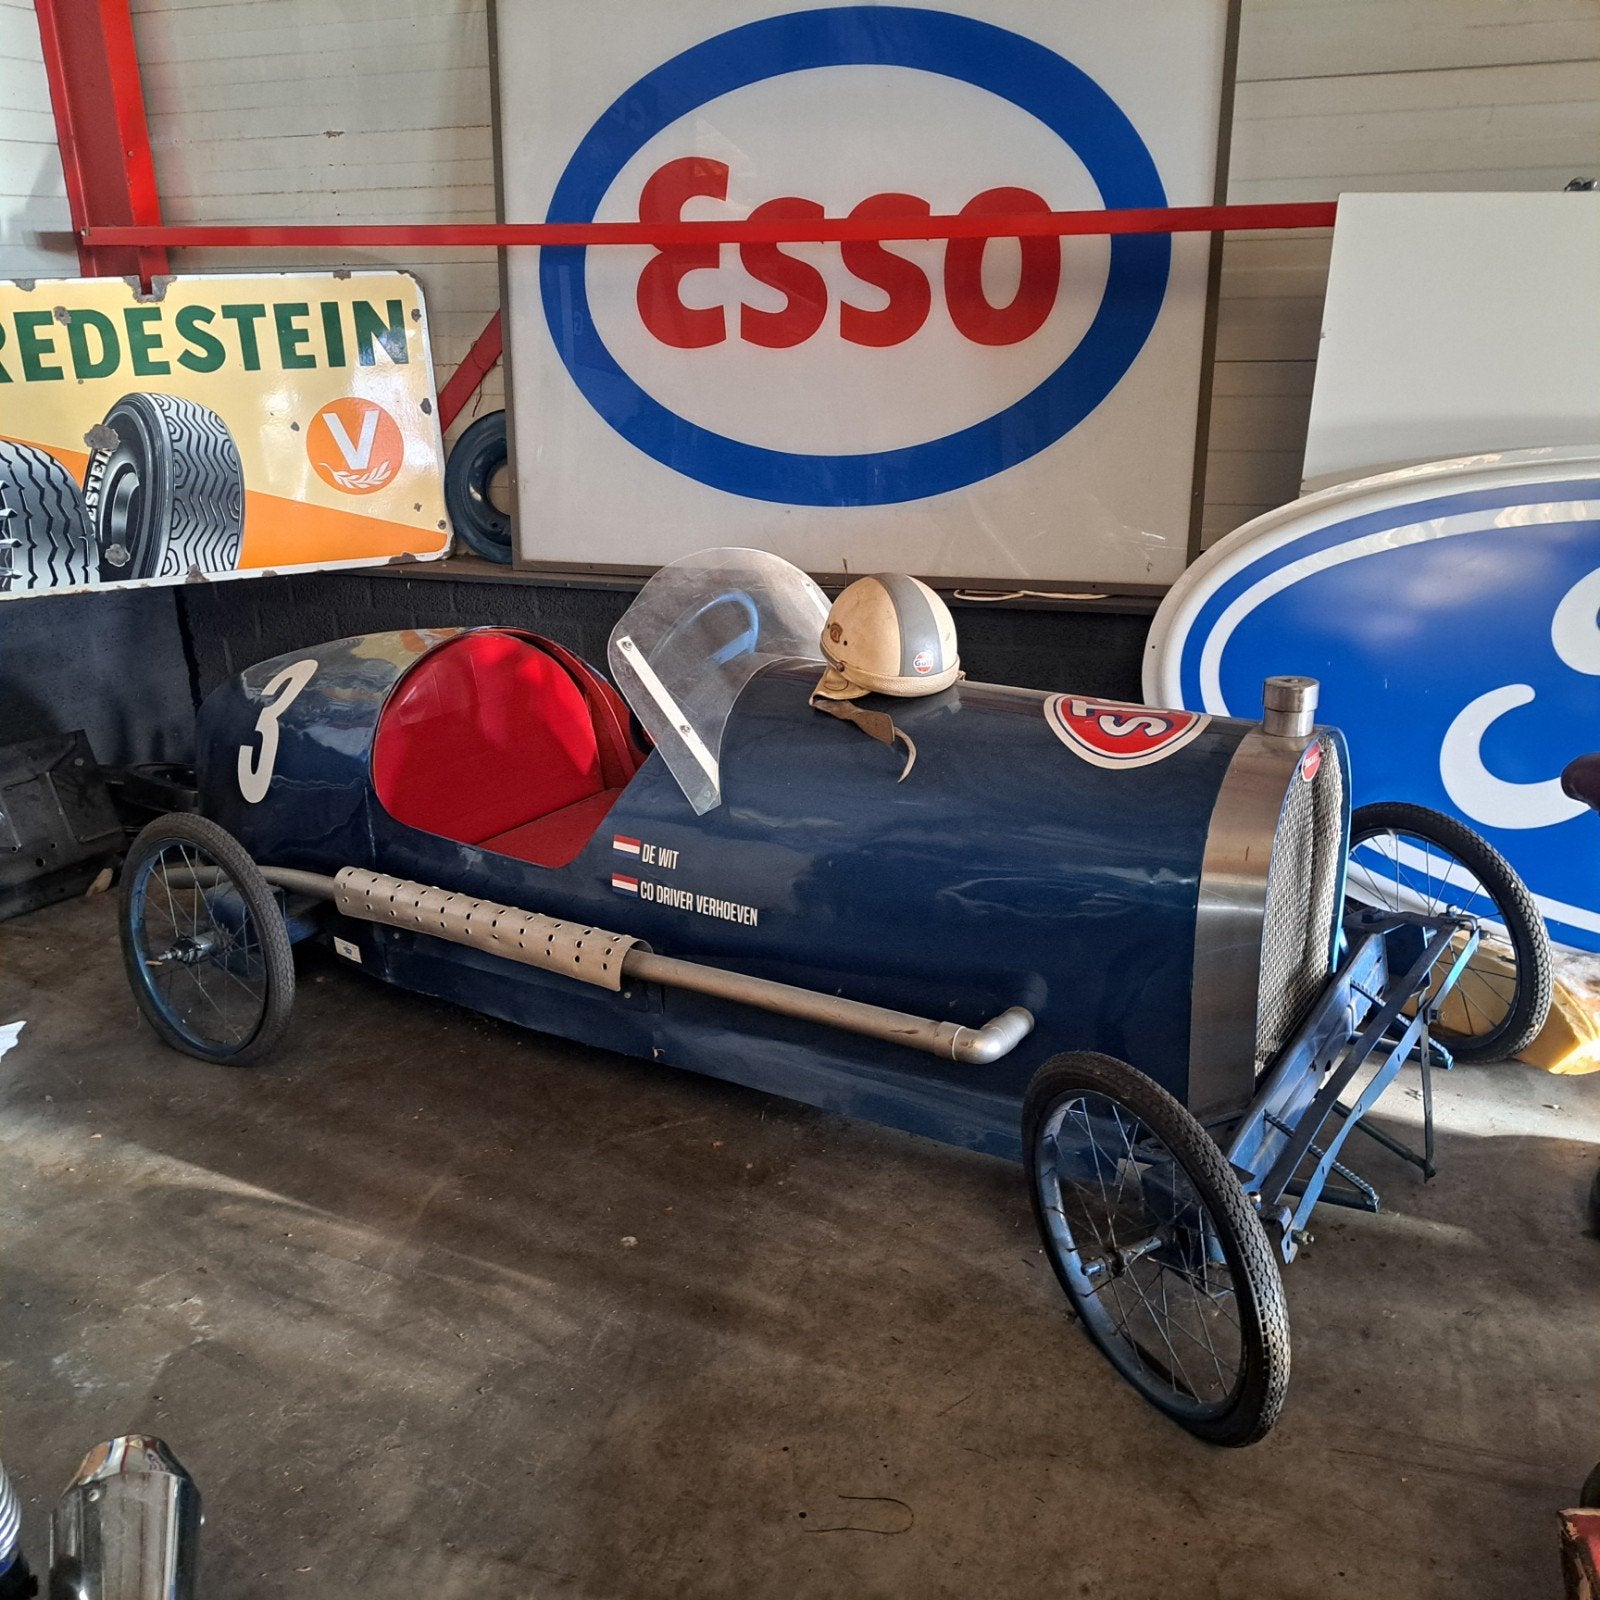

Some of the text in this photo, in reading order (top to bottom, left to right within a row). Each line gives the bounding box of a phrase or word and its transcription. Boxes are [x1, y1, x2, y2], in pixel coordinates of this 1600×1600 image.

[322, 409, 380, 471] V
[85, 447, 114, 536] ESTEI
[238, 659, 319, 804] 3
[1071, 698, 1171, 738] ST
[641, 843, 680, 870] DE WIT
[640, 881, 758, 927] CO DRIVER VERHOEVEN
